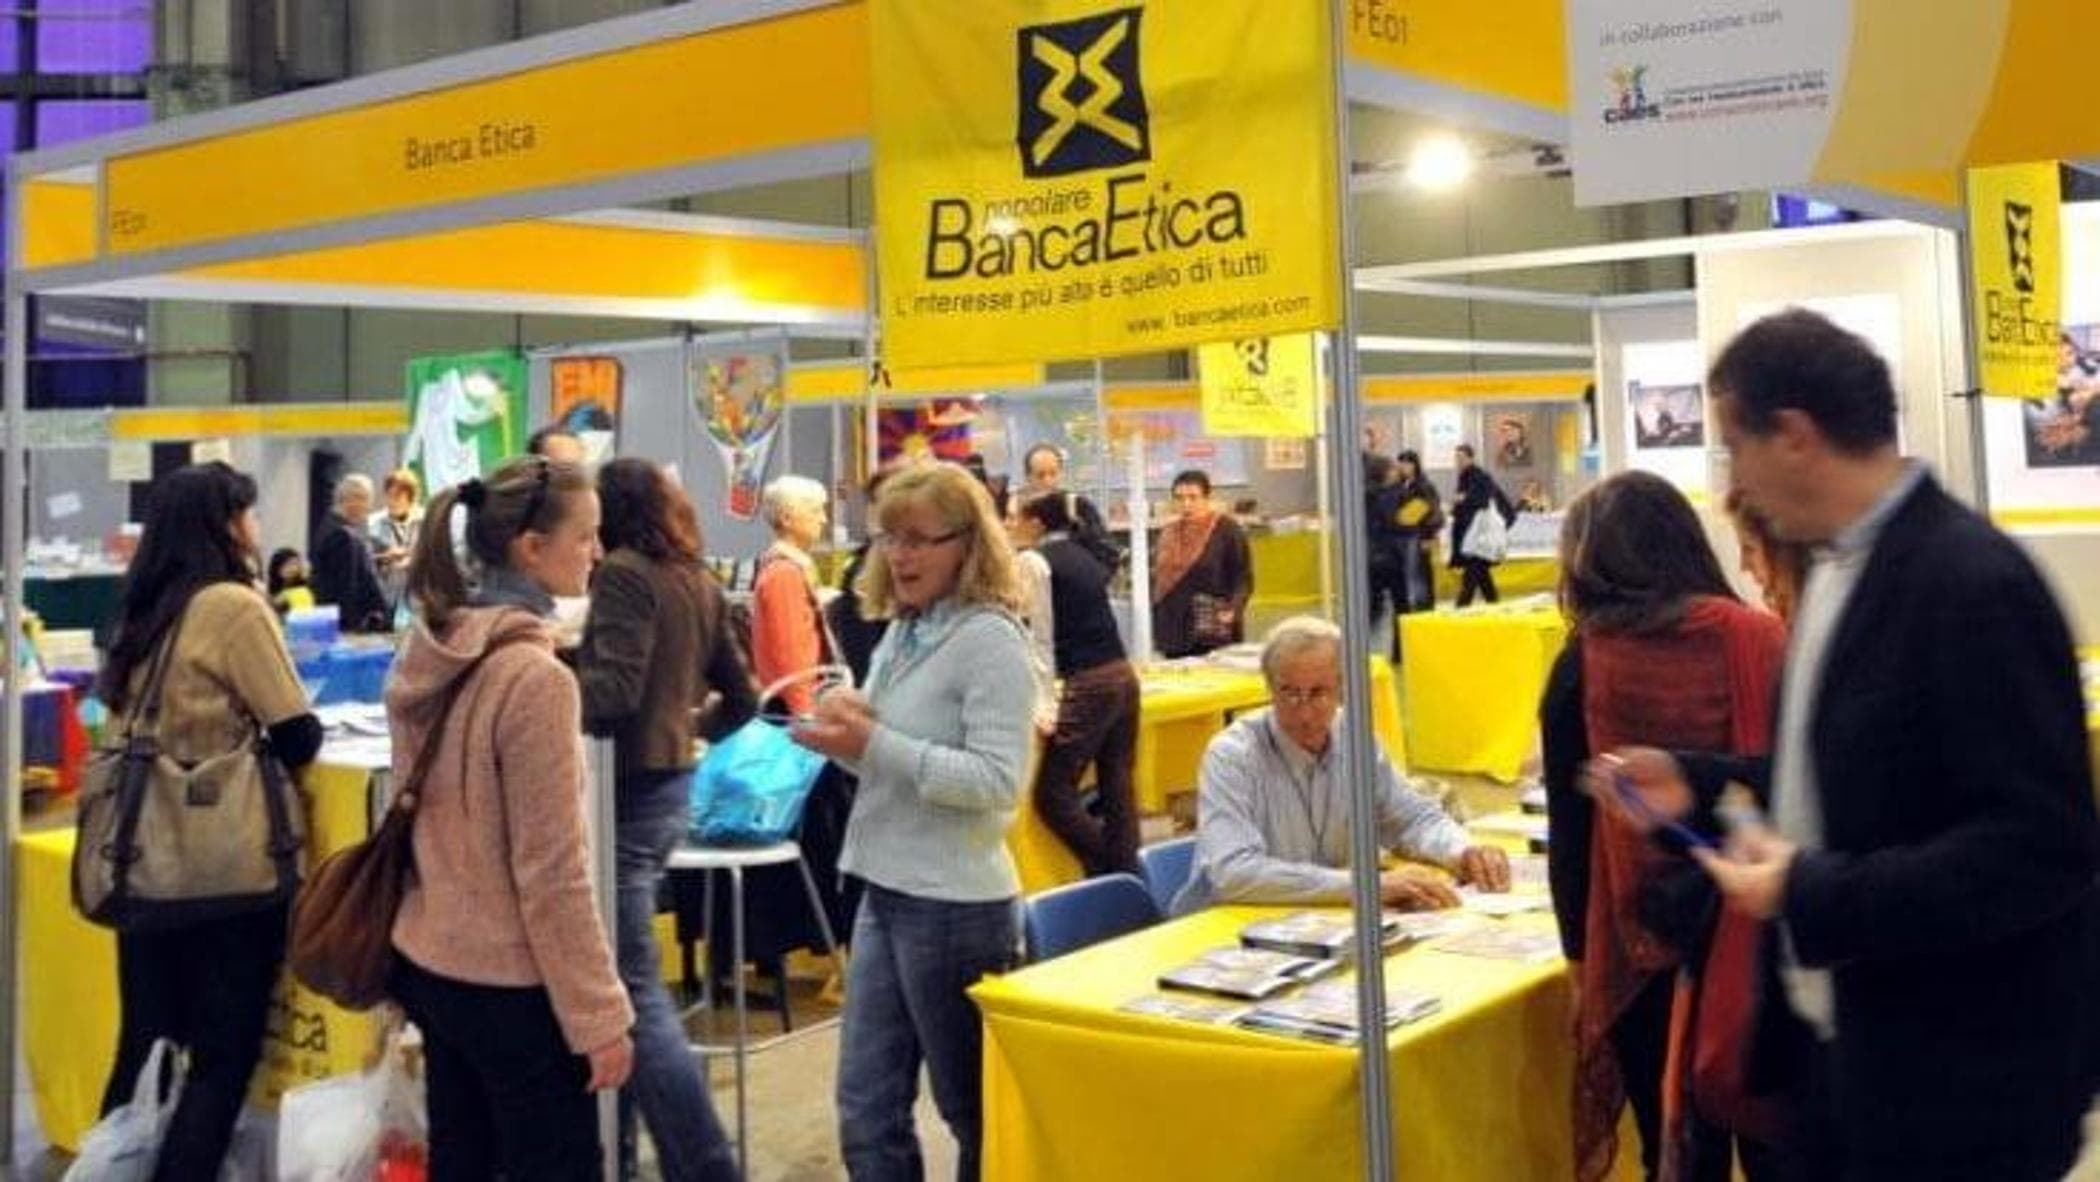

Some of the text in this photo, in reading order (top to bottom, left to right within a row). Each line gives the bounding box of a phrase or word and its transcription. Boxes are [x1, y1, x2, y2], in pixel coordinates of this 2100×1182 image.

[404, 122, 536, 170] Banca Etica
[984, 189, 1092, 228] popolare
[1119, 263, 1182, 298] quello
[1189, 256, 1214, 283] di
[1219, 251, 1269, 277] tutti
